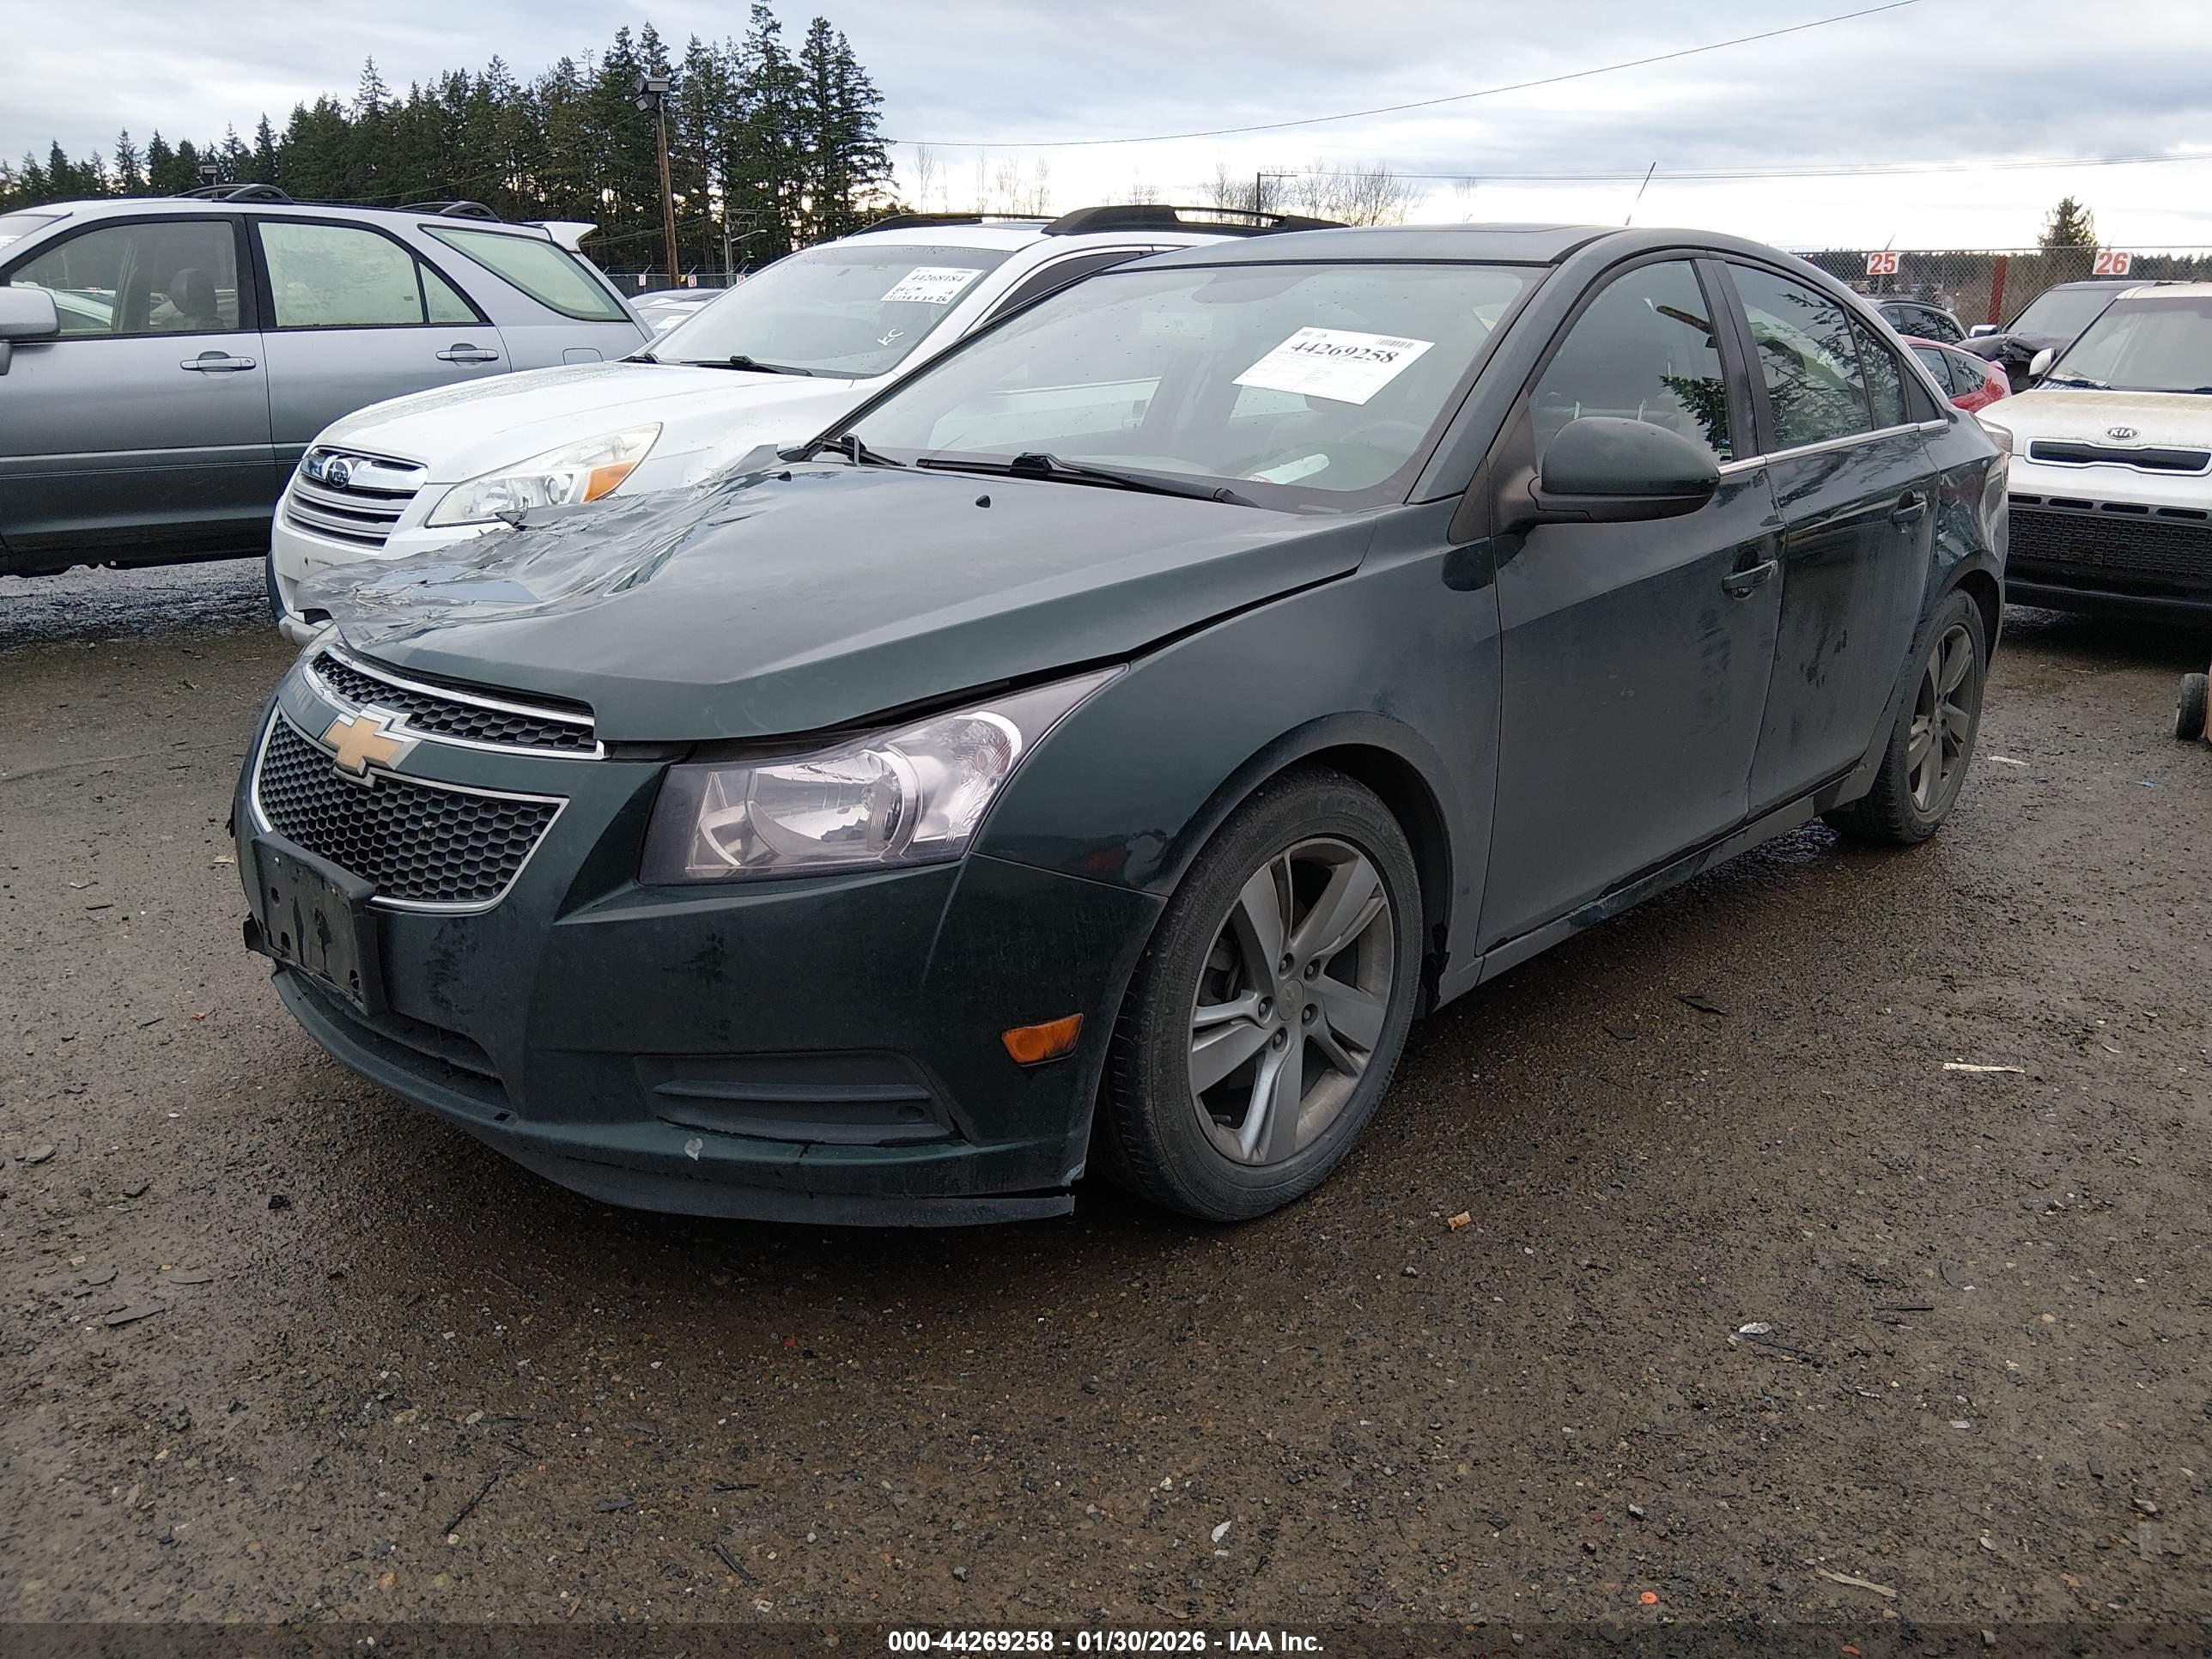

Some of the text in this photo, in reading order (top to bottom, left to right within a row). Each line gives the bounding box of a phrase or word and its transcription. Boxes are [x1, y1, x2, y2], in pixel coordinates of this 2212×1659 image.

[1869, 253, 1896, 273] 25
[2096, 252, 2128, 273] 26
[877, 328, 904, 345] KC
[1291, 341, 1399, 363] 44269258
